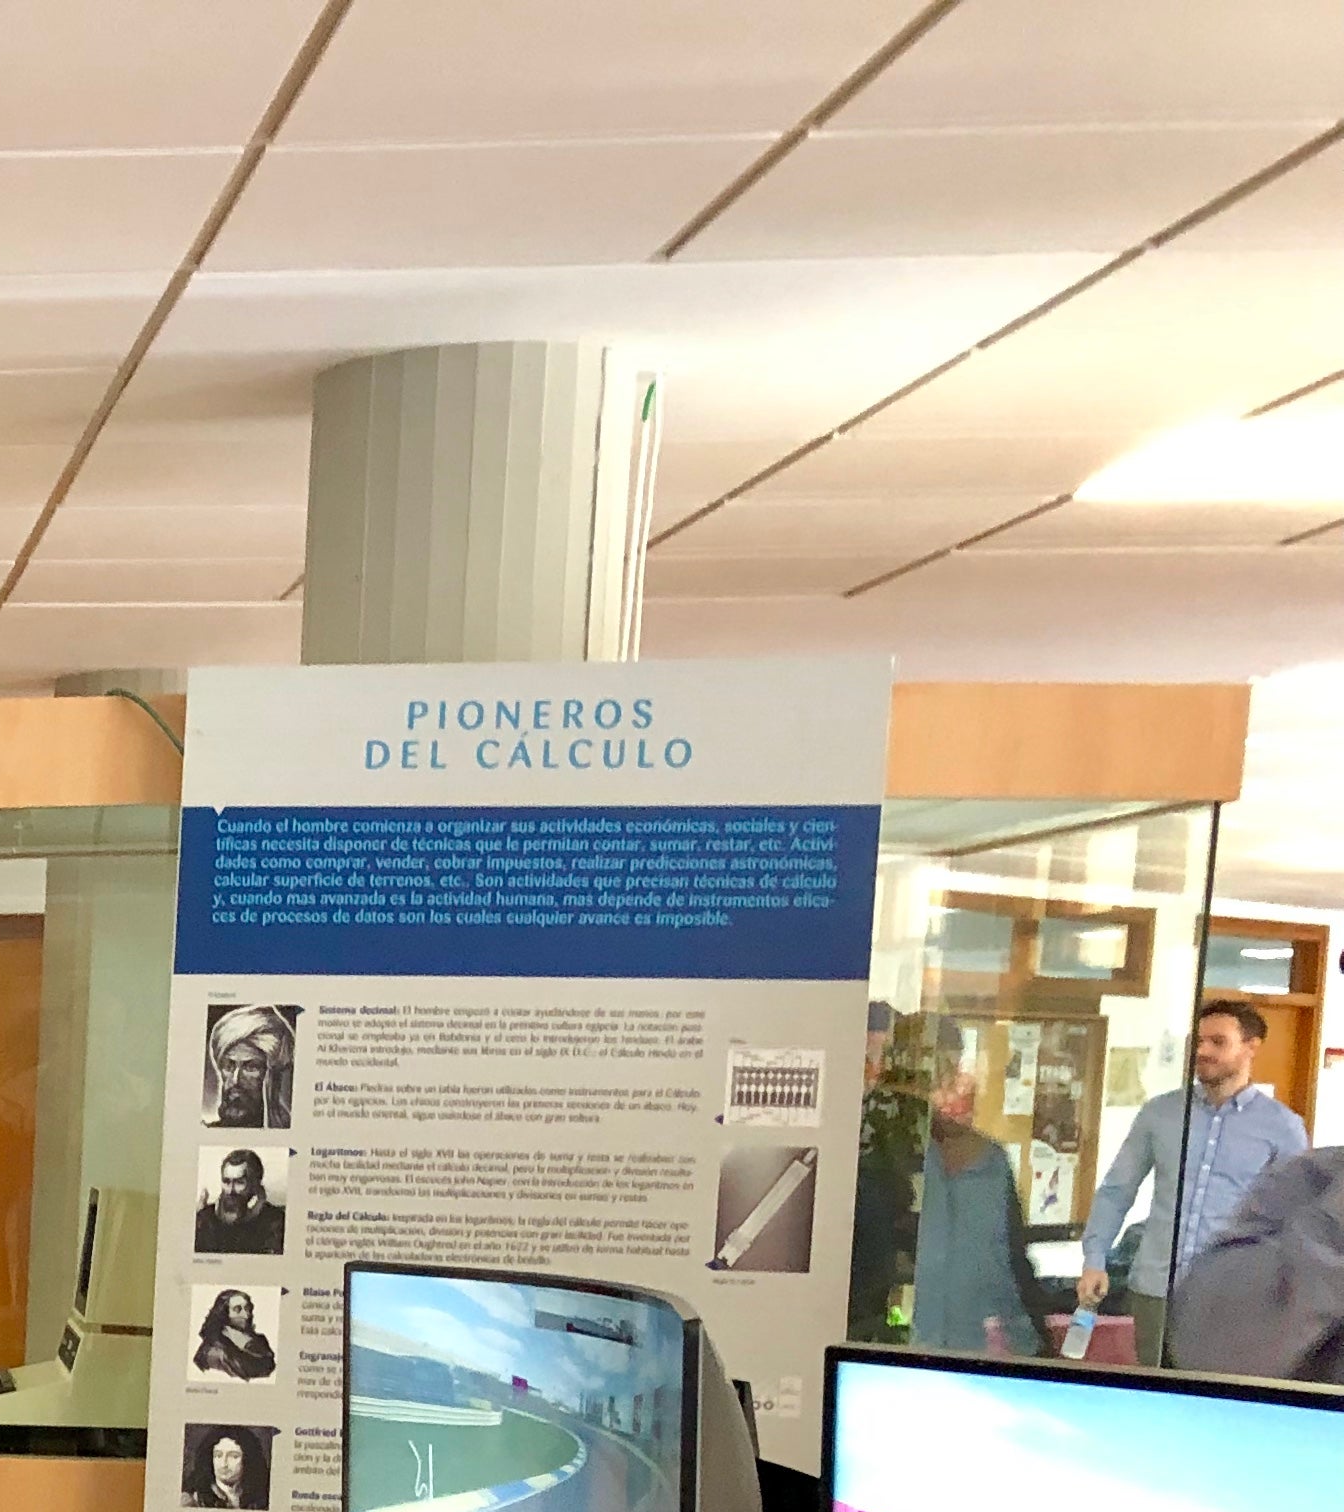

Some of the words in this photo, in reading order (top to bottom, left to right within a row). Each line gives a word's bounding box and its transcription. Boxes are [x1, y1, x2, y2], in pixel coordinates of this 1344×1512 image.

[406, 699, 653, 731] PIONEROS
[364, 739, 447, 770] DEL
[476, 730, 693, 770] CÁLCULO
[216, 819, 272, 832] Cuando
[275, 819, 288, 832] el
[291, 819, 348, 832] hombre
[352, 819, 421, 832] comienza
[424, 822, 433, 832] a
[437, 819, 506, 836] organizar
[510, 822, 536, 832] sus
[538, 818, 622, 832] actividades
[724, 818, 785, 832] sociales
[789, 822, 798, 836] y
[260, 837, 320, 850] necesita
[322, 837, 387, 854] disponer
[390, 837, 409, 850] de
[474, 840, 502, 854] que
[505, 837, 519, 850] le
[522, 837, 589, 854] permitan
[214, 855, 256, 868] dades
[260, 858, 301, 868] como
[433, 855, 483, 868] cobrar
[570, 855, 626, 868] realizar
[629, 855, 726, 873] predicciones
[213, 873, 270, 886] calcular
[272, 873, 343, 890] superficie
[346, 873, 365, 886] de
[474, 873, 503, 886] Son
[506, 873, 589, 886] actividades
[592, 876, 621, 890] que
[624, 873, 689, 891] precisan
[758, 874, 778, 887] de
[781, 874, 836, 887] cálculo
[229, 891, 282, 904] cuando
[319, 891, 386, 904] avanzada
[389, 894, 406, 904] es
[410, 891, 423, 904] la
[426, 891, 492, 904] actividad
[597, 891, 662, 909] depende
[665, 892, 684, 905] de
[688, 892, 788, 905] instrumentos
[211, 912, 236, 922] ces
[239, 909, 258, 922] de
[261, 912, 328, 926] procesos
[332, 909, 350, 922] de
[354, 909, 394, 922] datos
[398, 912, 425, 922] son
[429, 909, 451, 922] los
[455, 909, 501, 923] cuales
[506, 910, 574, 927] cualquier
[577, 913, 630, 923] avance
[634, 913, 651, 923] es
